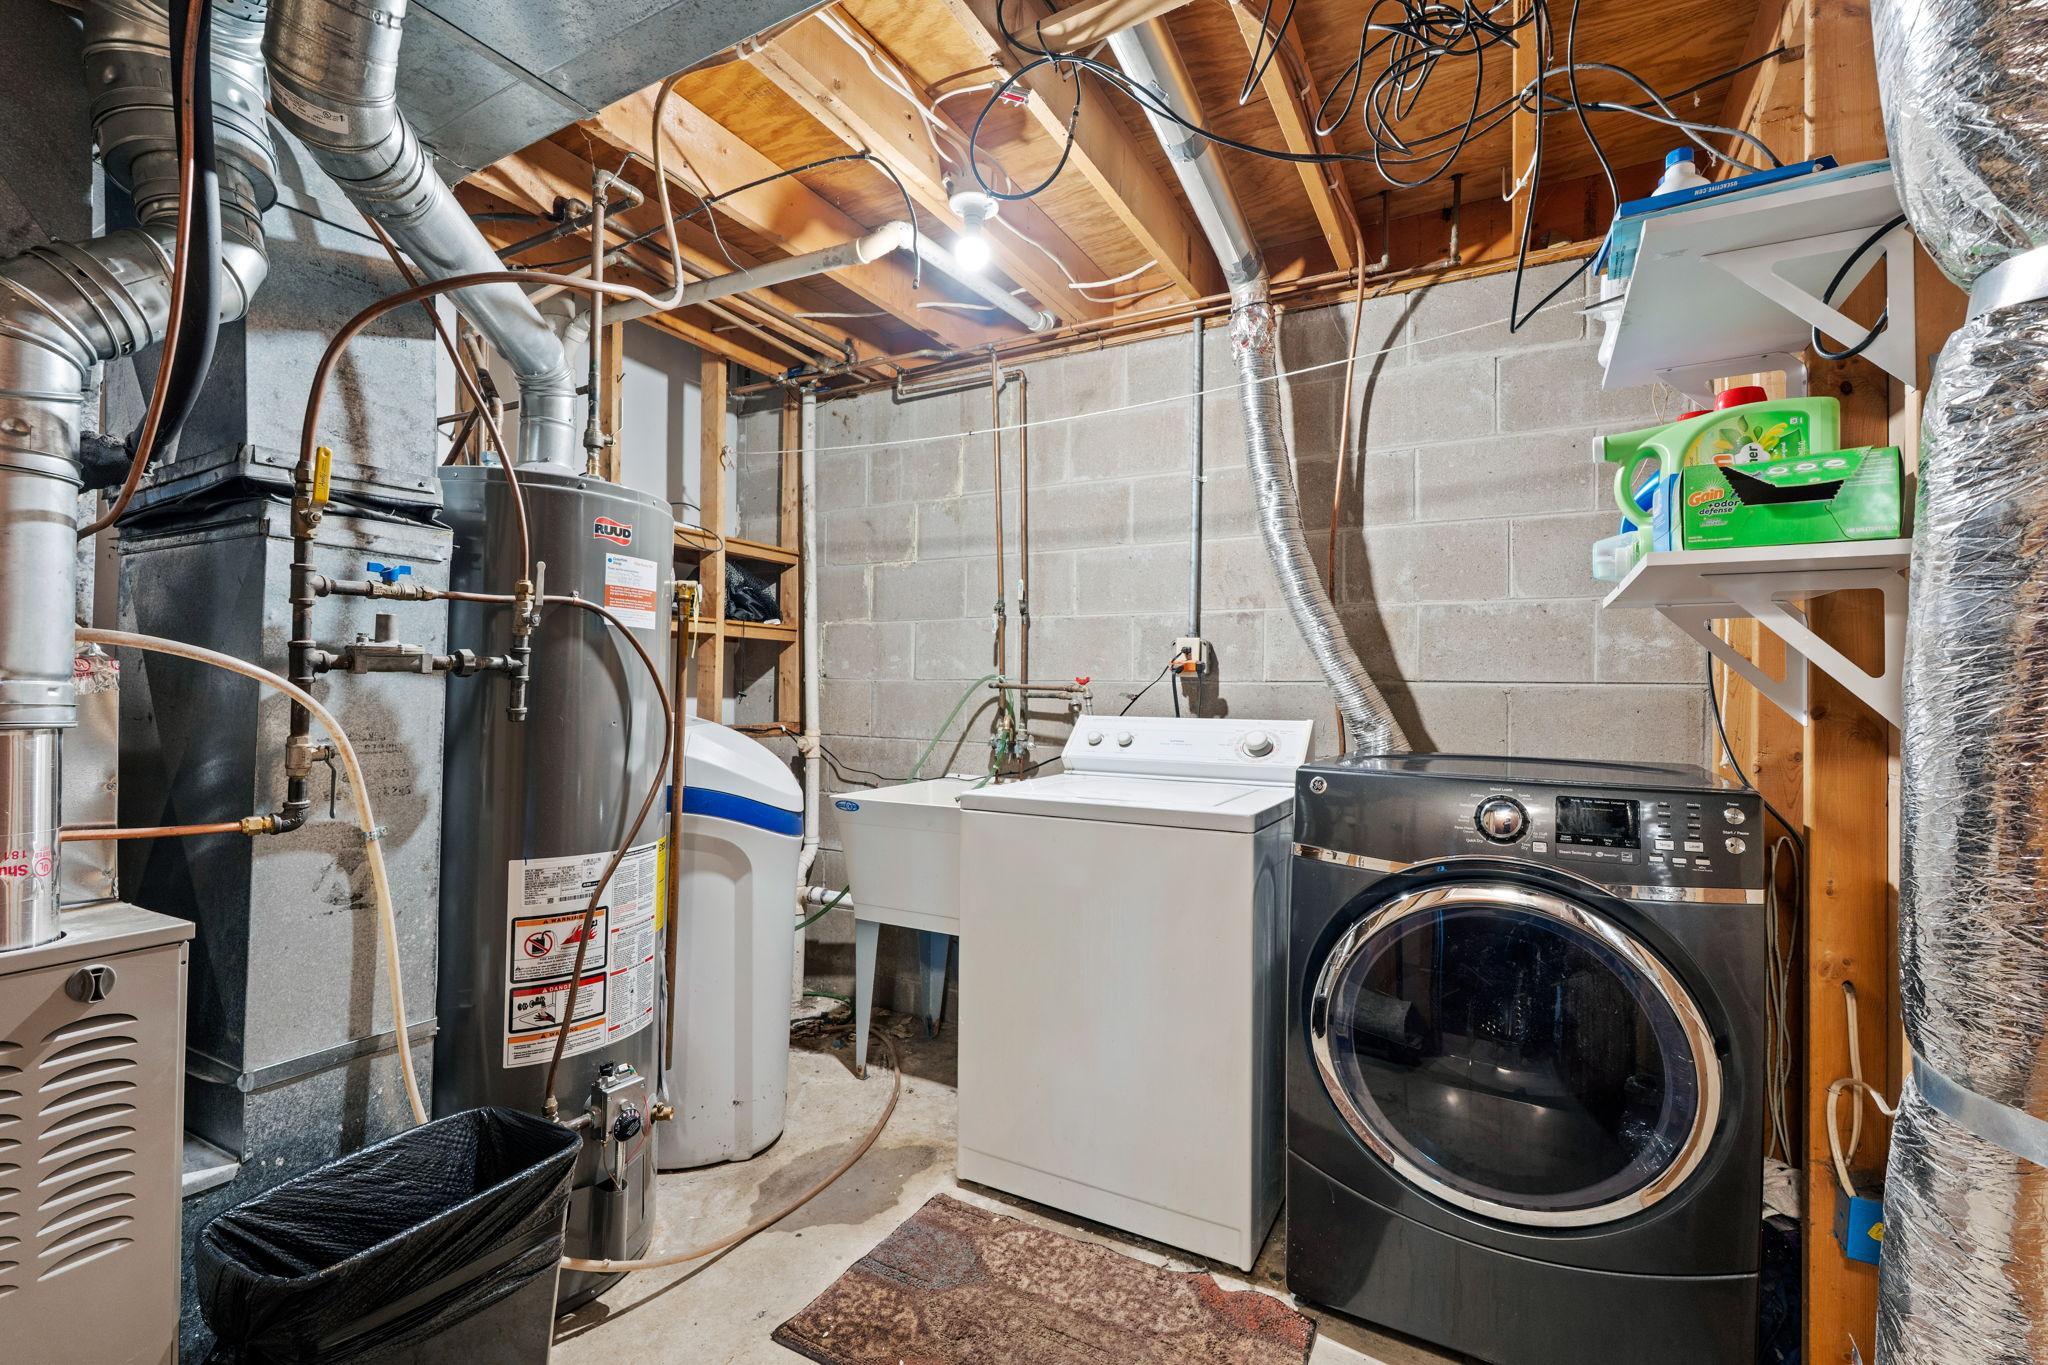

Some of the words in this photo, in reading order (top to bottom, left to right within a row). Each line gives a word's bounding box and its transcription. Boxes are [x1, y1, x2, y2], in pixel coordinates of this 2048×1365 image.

[1688, 488, 1725, 507] Gain
[595, 523, 632, 538] RUUD
[551, 914, 584, 924] WARNING
[549, 984, 573, 992] DANGE
[549, 1027, 579, 1036] WANG
